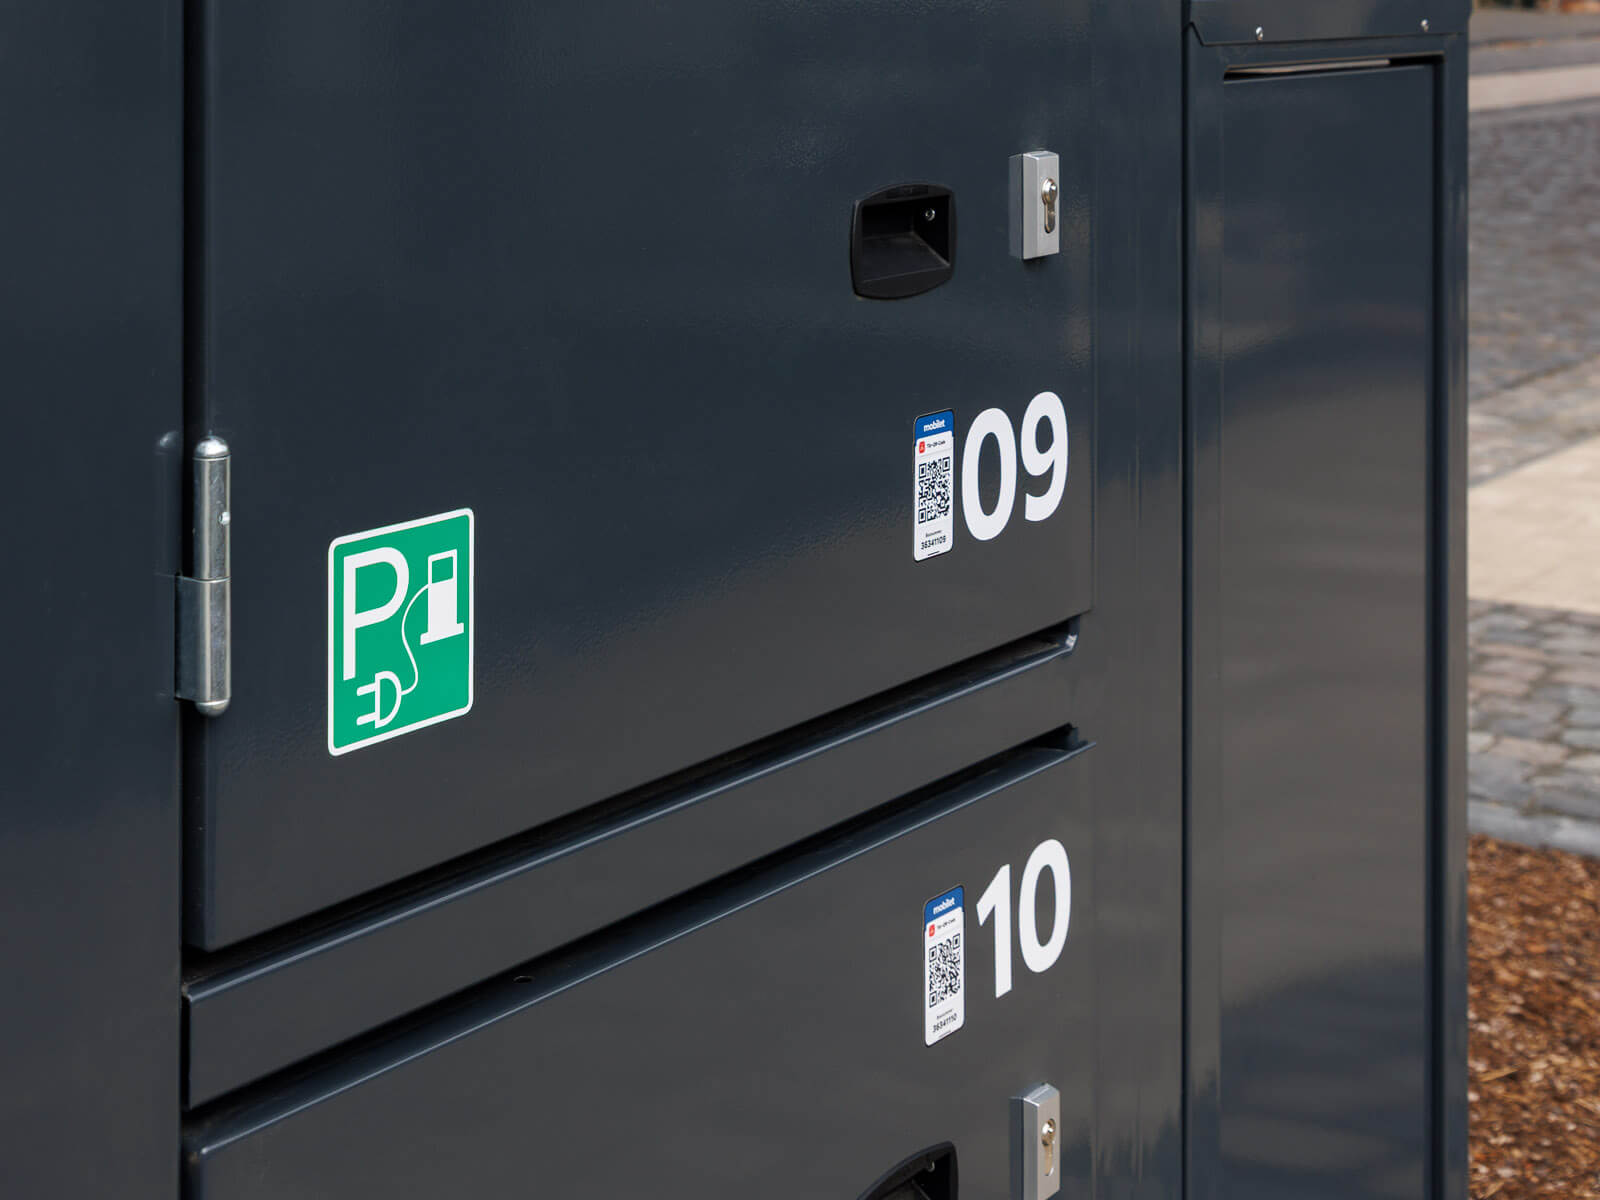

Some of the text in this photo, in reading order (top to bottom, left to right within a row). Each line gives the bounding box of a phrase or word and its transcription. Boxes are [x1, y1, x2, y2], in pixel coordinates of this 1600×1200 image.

[923, 419, 946, 432] mobilet
[961, 391, 1069, 541] 09
[932, 896, 956, 916] mobilet
[976, 838, 1072, 999] 10
